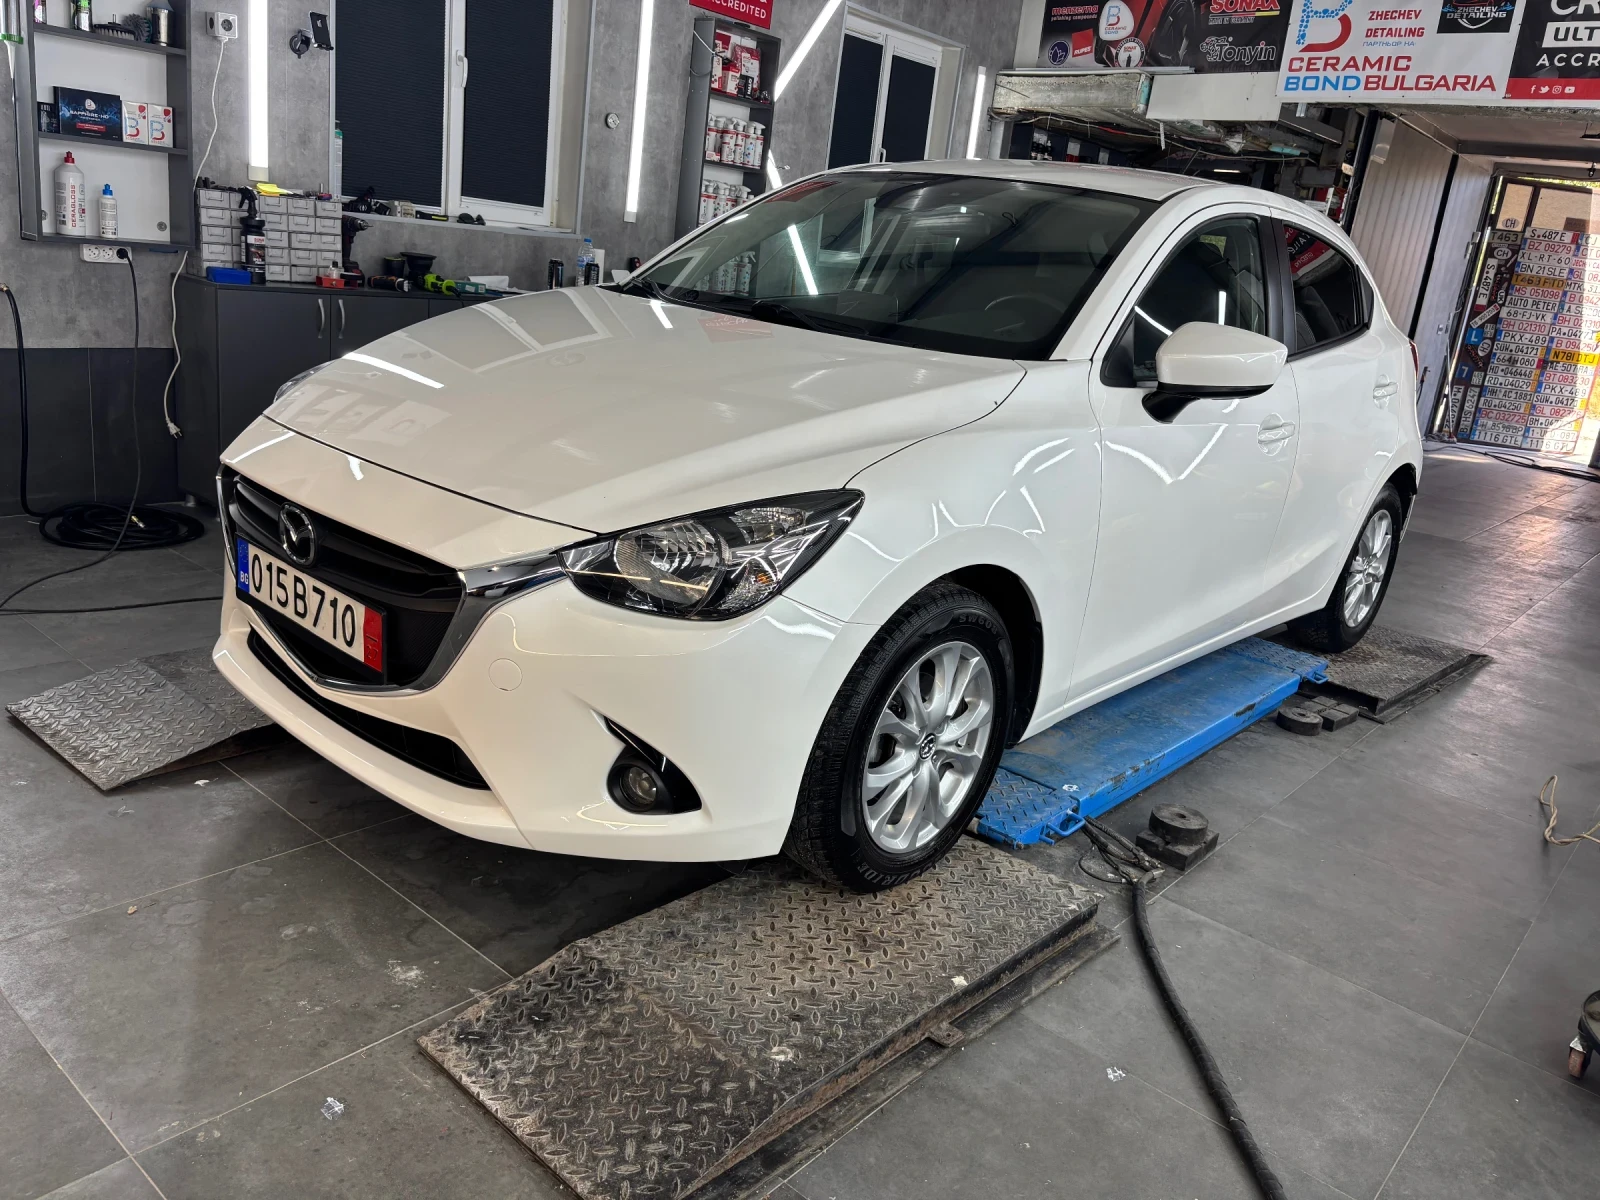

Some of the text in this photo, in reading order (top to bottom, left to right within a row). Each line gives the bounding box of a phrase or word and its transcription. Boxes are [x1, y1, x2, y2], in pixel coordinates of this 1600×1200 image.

[1052, 5, 1098, 15] menzerna
[1209, 0, 1280, 13] SONAX
[1368, 9, 1422, 21] ZHECHEV
[1446, 11, 1507, 19] DETAILING
[1365, 27, 1425, 38] DETAILING
[1074, 46, 1092, 55] RUPES
[1215, 42, 1276, 65] Tonyin
[1288, 56, 1411, 72] CERAMIC
[1535, 53, 1600, 67] ACCR
[1284, 75, 1497, 91] BOND BULGARIA
[1505, 219, 1516, 228] CH
[1492, 232, 1518, 242] T463
[1528, 241, 1572, 254] BZ 09279
[1520, 264, 1566, 277] BN 21 SLE
[1515, 274, 1564, 288] T463 FTD
[1513, 286, 1560, 299] MS 051098
[1508, 297, 1557, 311] AUTO PETER
[1506, 310, 1547, 321] 68-FJ-VK
[1557, 315, 1571, 325] BH
[1502, 320, 1546, 333] BH 021310
[1471, 331, 1478, 341] L
[1503, 332, 1547, 345] PKX-489
[1576, 354, 1596, 364] DTJ
[1462, 366, 1469, 378] 7
[1544, 373, 1557, 382] BT
[1487, 387, 1533, 402] HH AC 1881
[1543, 384, 1586, 398] PKX-489
[1480, 409, 1527, 424] BC 032725
[1535, 406, 1545, 415] GL
[1477, 431, 1500, 442] 1116
[240, 571, 249, 585] BG
[251, 553, 356, 648] 015B710
